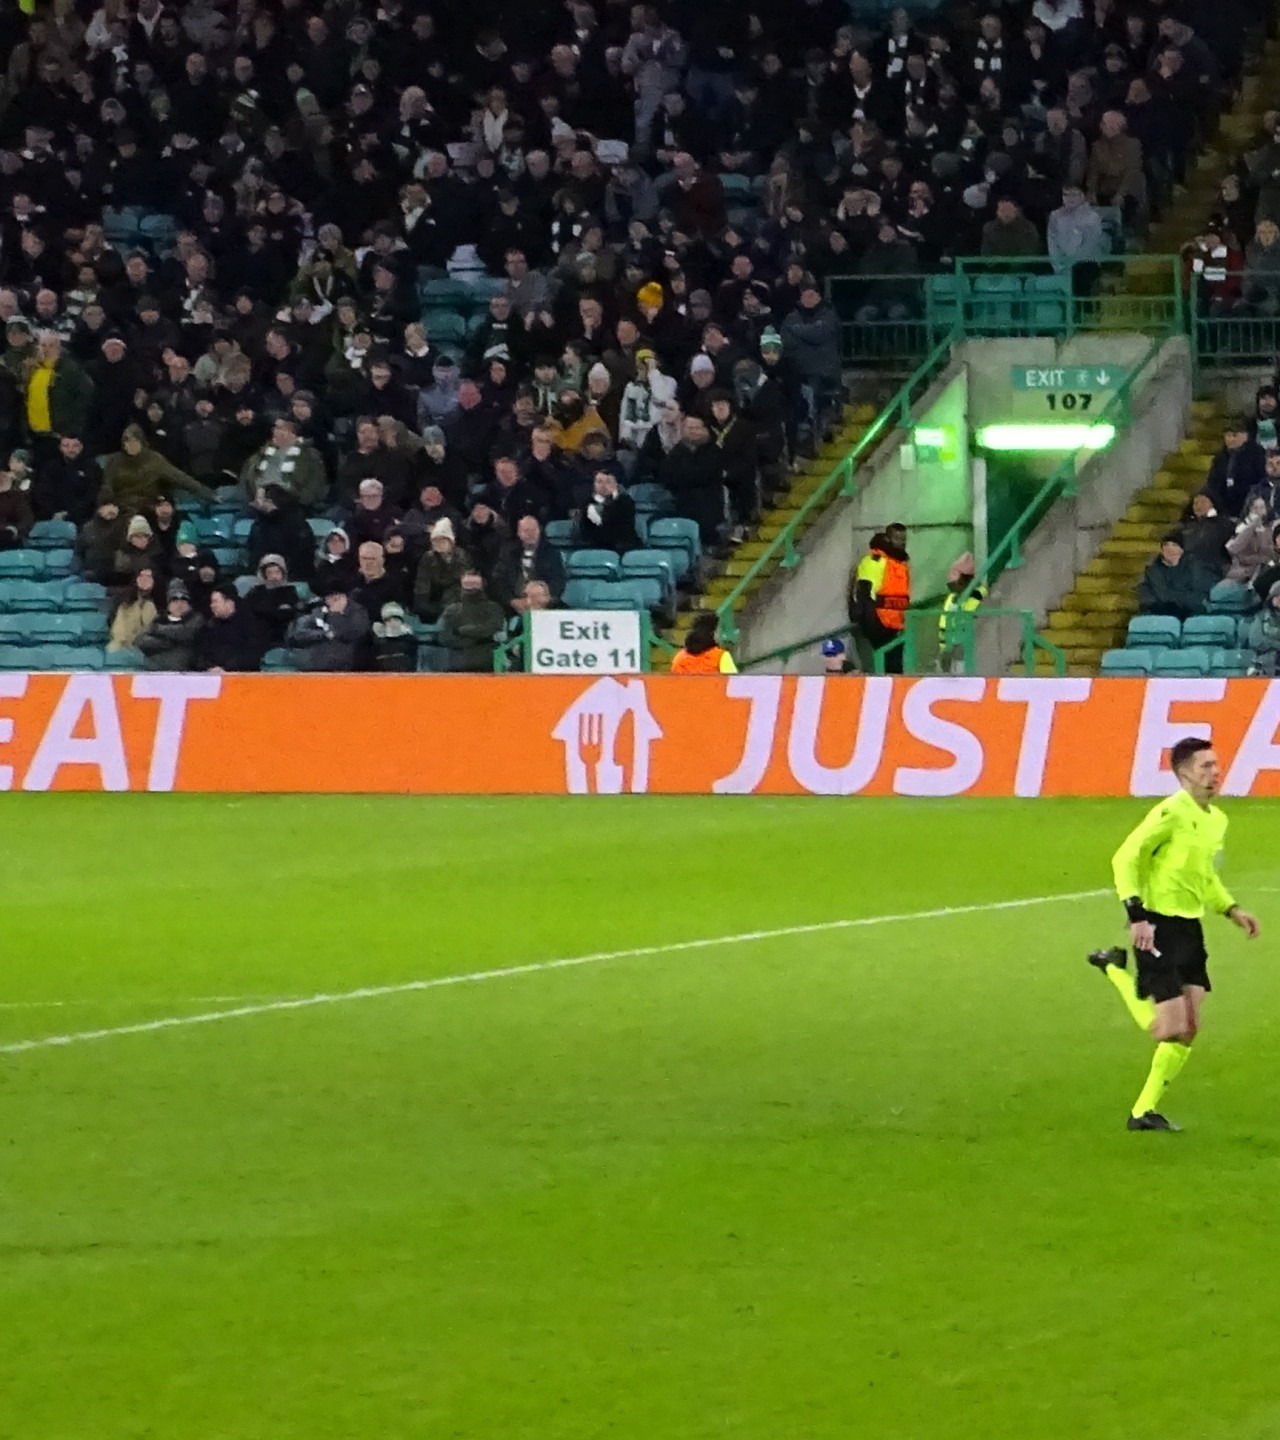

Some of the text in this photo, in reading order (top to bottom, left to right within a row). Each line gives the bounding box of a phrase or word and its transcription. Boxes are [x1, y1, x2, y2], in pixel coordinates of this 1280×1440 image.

[1026, 369, 1064, 387] EXIT
[1046, 393, 1092, 411] 107
[560, 621, 611, 640] Exit
[536, 648, 636, 668] Gate 11
[713, 675, 1091, 796] JUST
